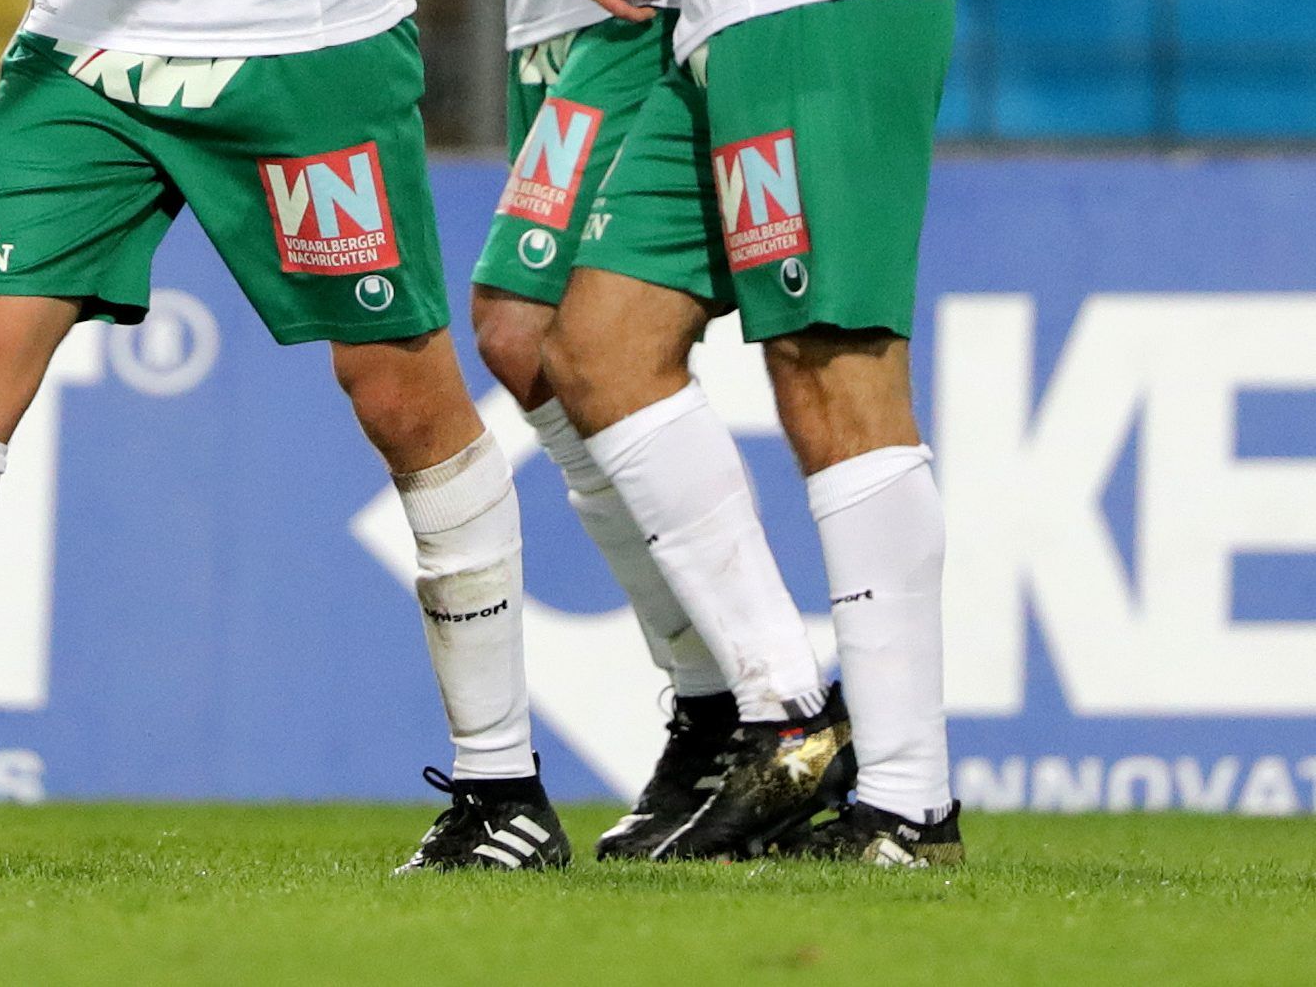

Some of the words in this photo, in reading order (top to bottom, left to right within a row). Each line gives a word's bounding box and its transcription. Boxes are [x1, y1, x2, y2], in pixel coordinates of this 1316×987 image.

[265, 151, 383, 239] VN
[715, 136, 802, 235] VN
[284, 231, 387, 254] VORARLBERGER
[287, 249, 379, 268] NACHRICHTEN
[955, 754, 1316, 816] NNOVA
